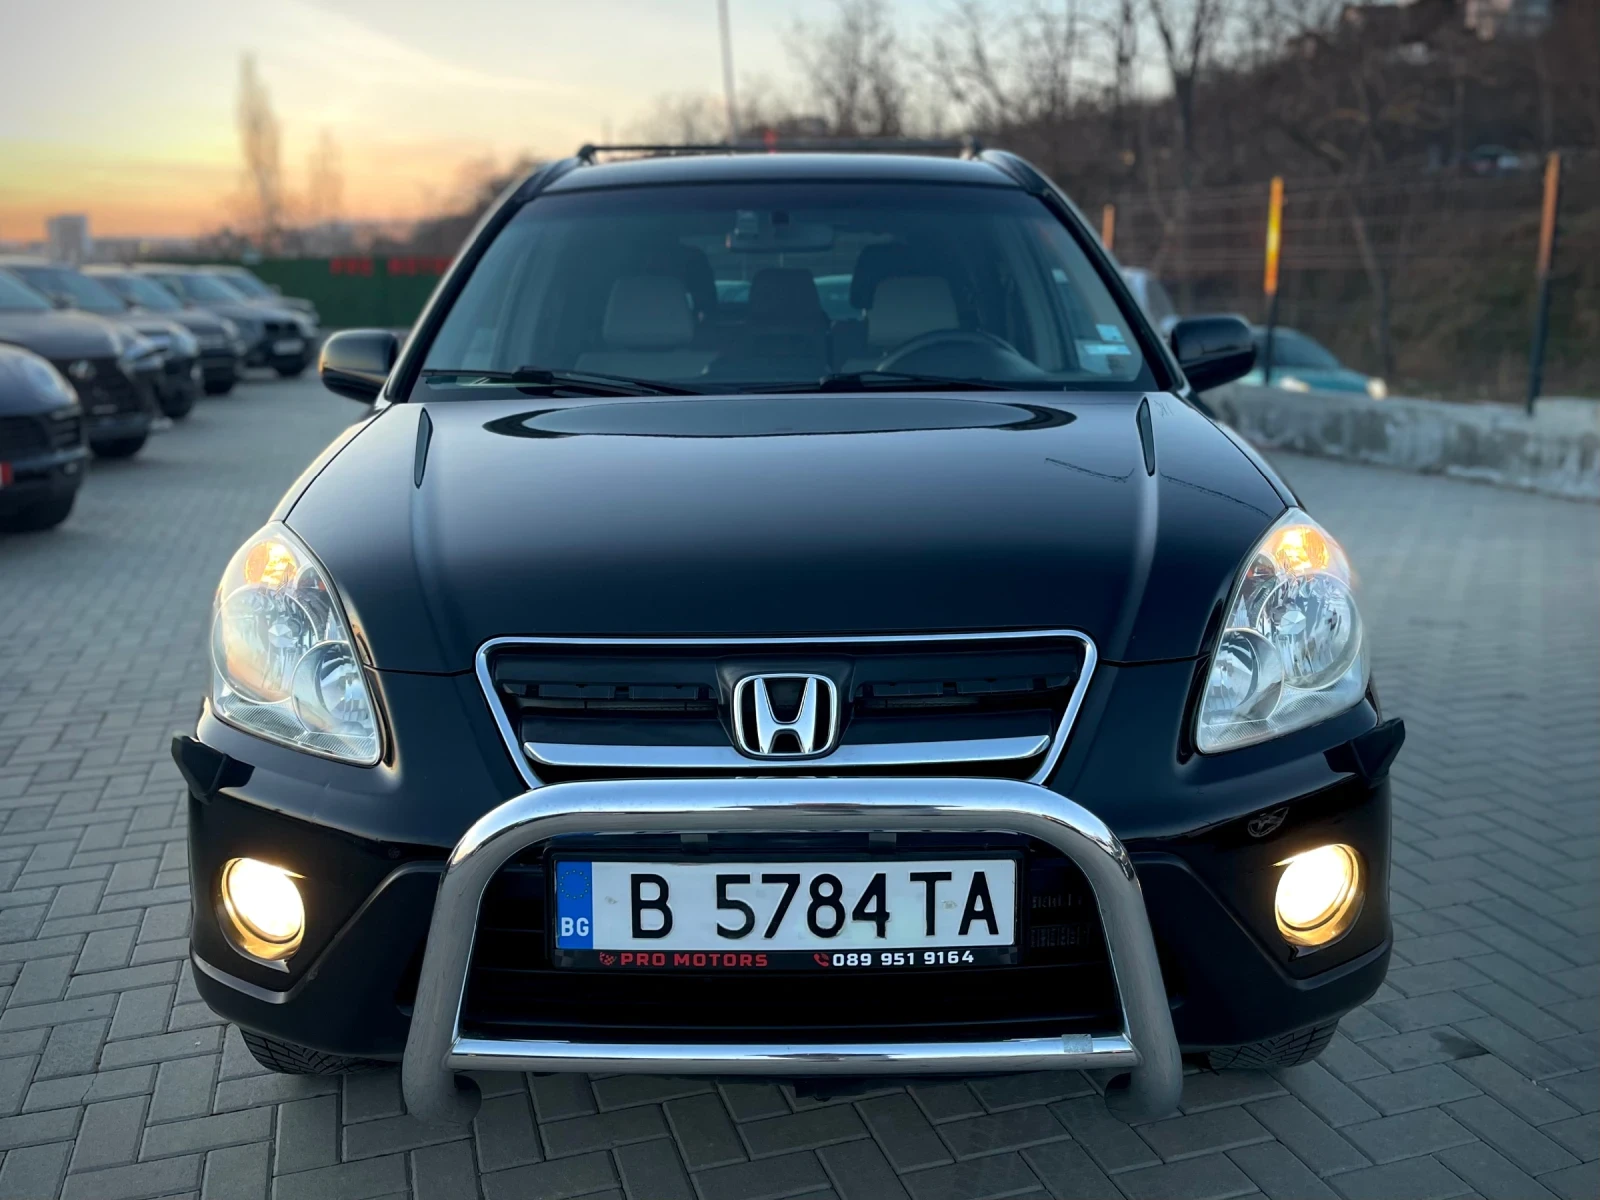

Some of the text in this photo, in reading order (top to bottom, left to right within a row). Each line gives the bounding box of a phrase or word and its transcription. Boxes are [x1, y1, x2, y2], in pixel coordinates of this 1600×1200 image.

[630, 871, 1000, 940] B 5784 TA
[560, 917, 590, 938] BG
[620, 952, 768, 967] PRO MOTORS
[832, 950, 975, 967] 089 951 9164
